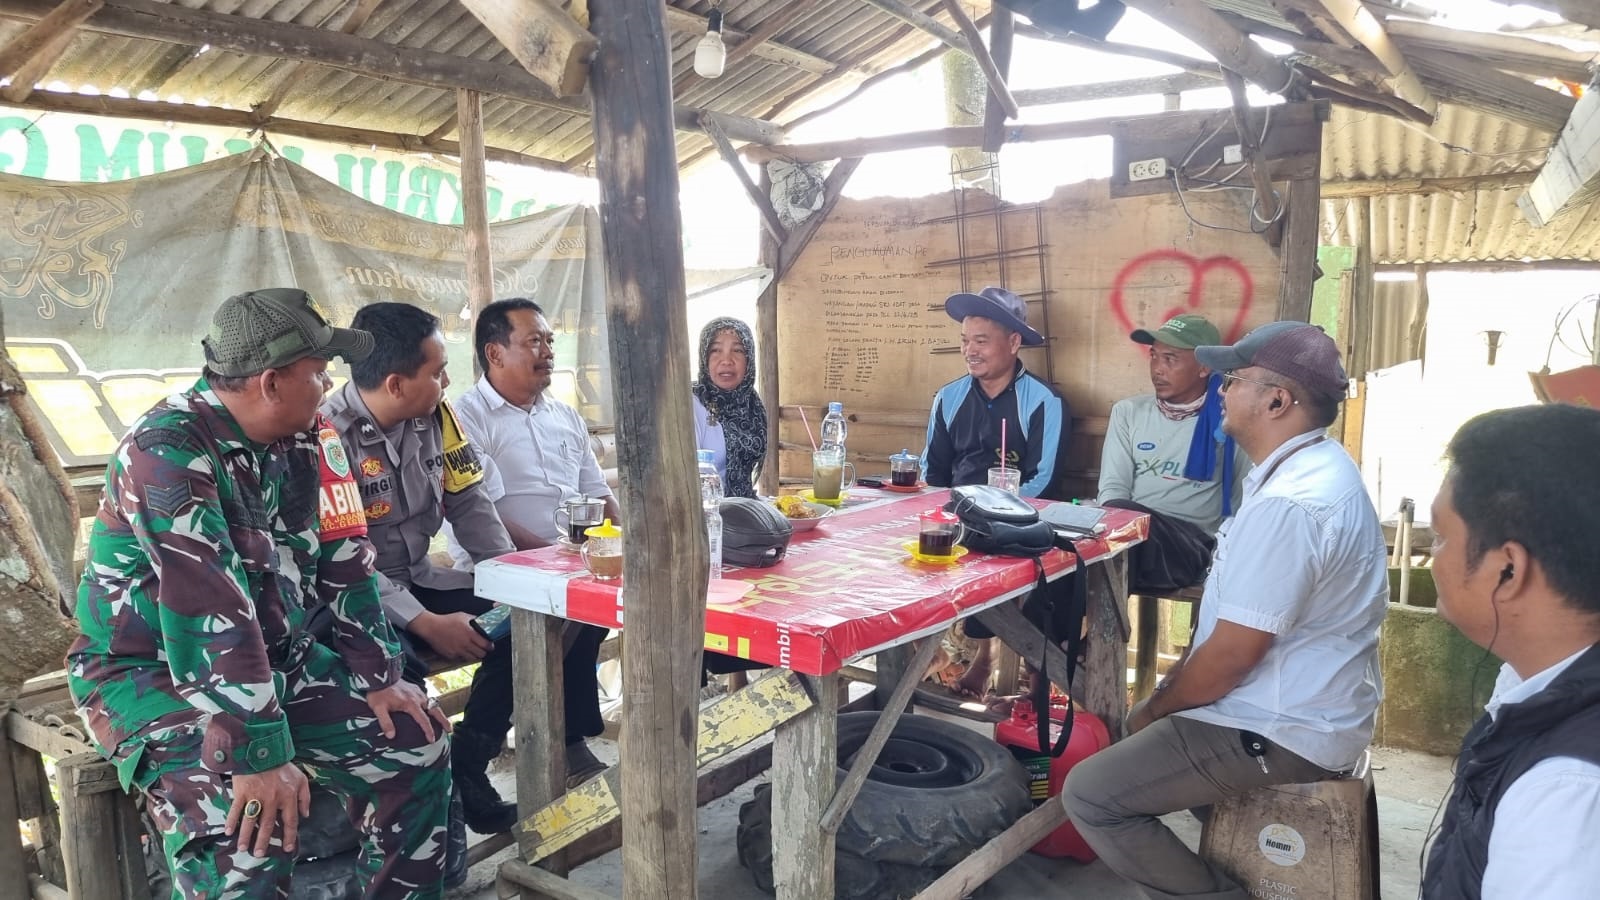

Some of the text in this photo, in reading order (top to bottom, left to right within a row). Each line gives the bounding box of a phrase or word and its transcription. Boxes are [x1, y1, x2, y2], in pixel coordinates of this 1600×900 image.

[425, 455, 444, 471] PO
[1136, 458, 1181, 477] EXPL
[359, 477, 392, 496] IRGI
[1248, 887, 1297, 900] HOUSEW
[1259, 879, 1297, 895] PLASTIC
